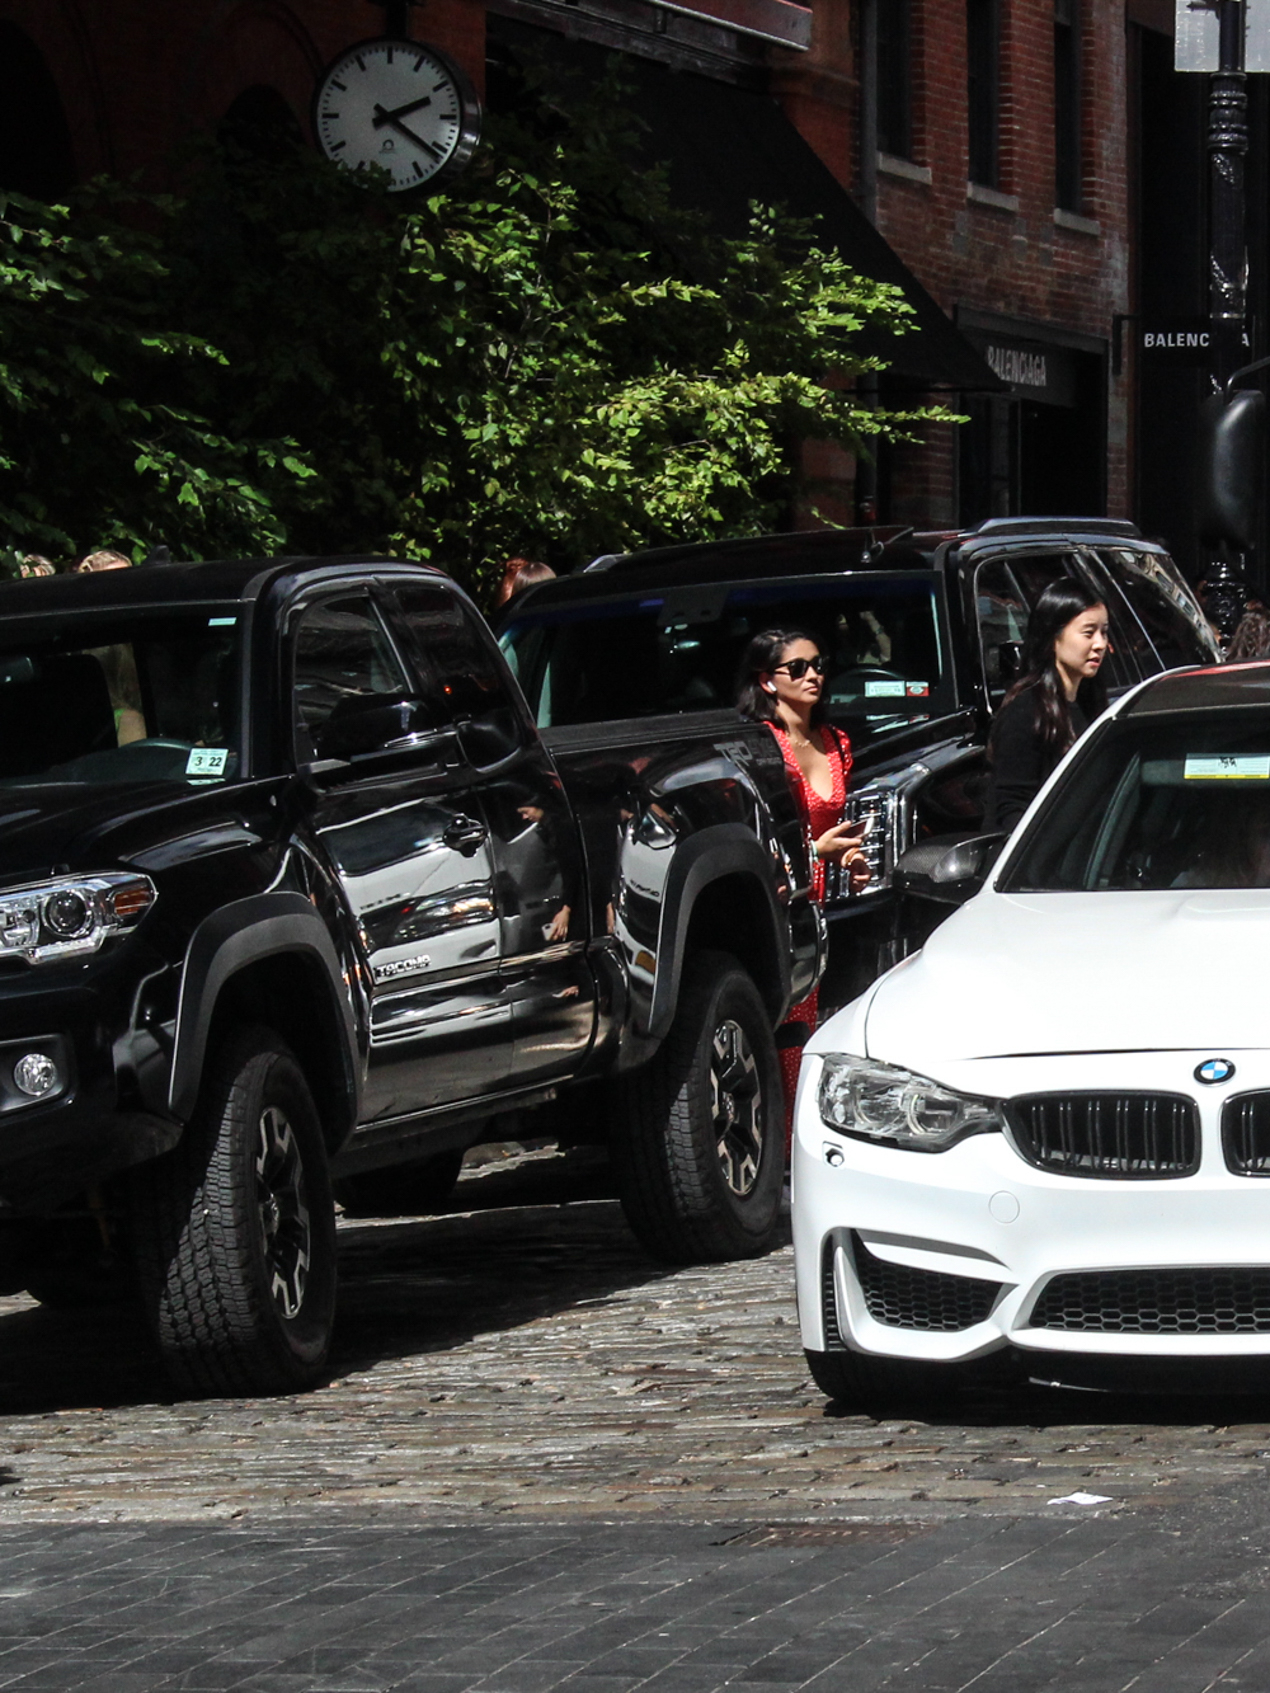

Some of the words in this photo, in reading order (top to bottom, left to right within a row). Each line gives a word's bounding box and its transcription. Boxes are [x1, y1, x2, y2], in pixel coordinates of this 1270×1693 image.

[1144, 332, 1250, 348] BALENCA
[194, 756, 203, 767] 3
[208, 756, 223, 767] 22
[376, 954, 432, 978] TACOMA
